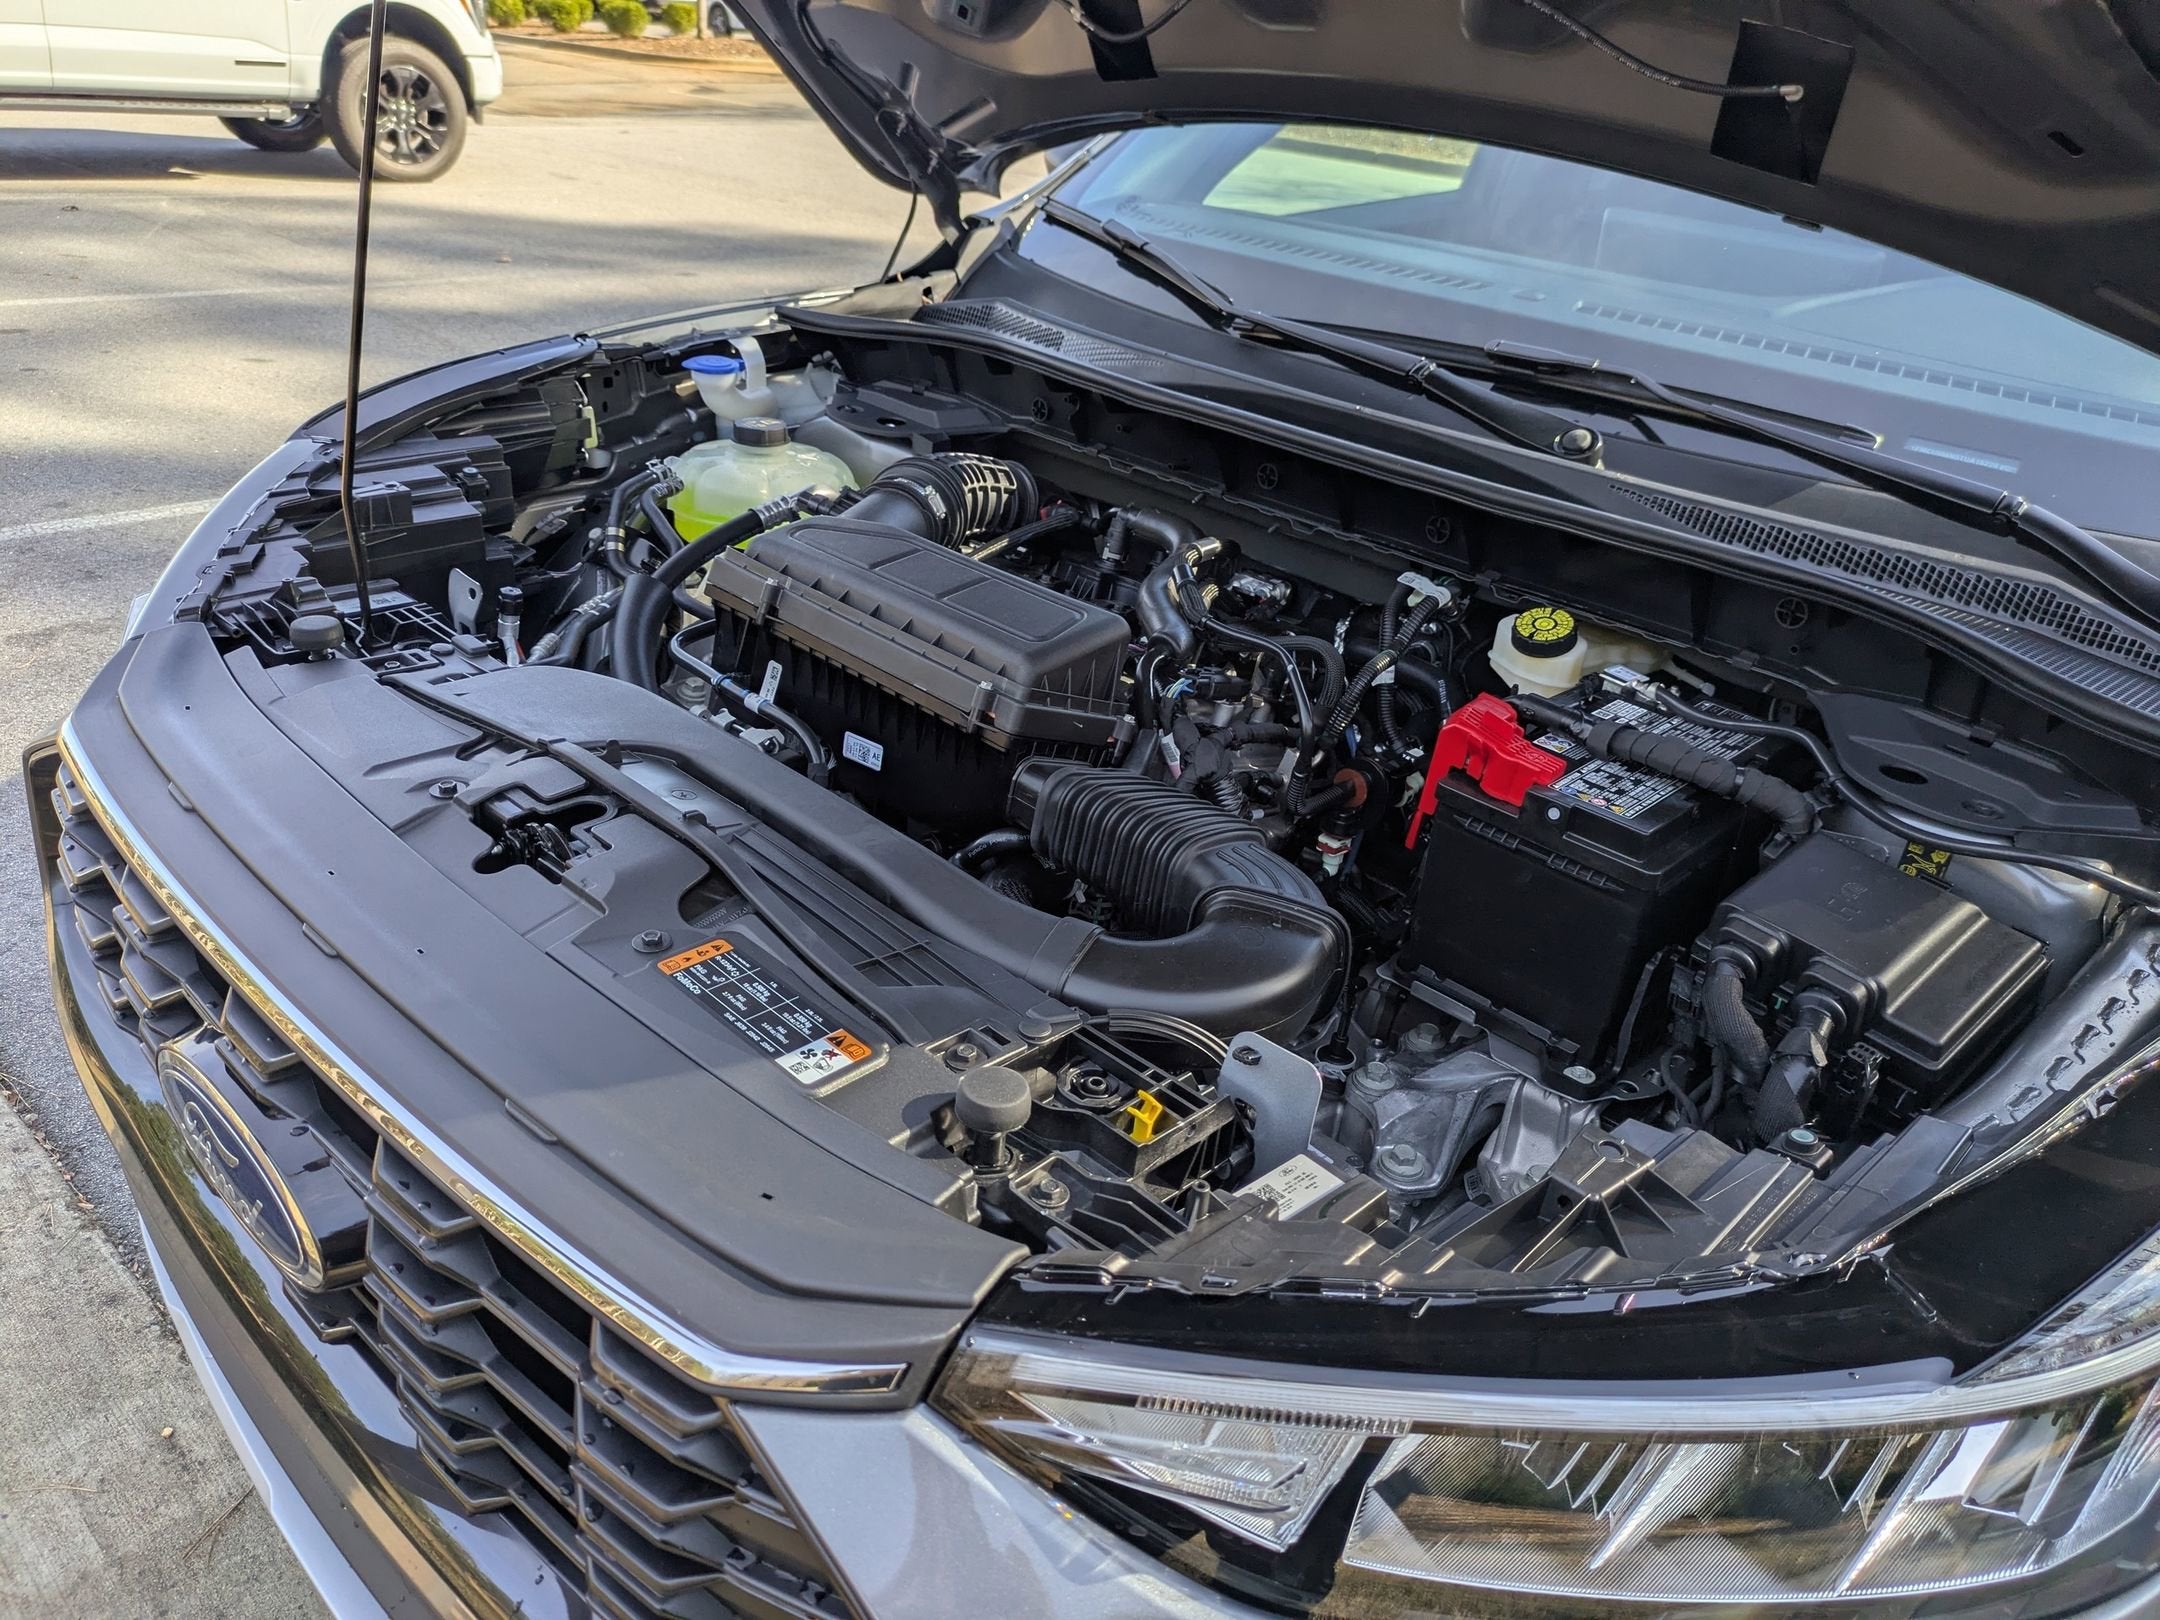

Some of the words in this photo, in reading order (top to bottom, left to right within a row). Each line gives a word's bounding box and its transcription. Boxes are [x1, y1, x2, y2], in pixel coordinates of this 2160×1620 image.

[872, 752, 881, 762] AE
[694, 964, 707, 974] PAG
[673, 972, 700, 994] FoMoCo
